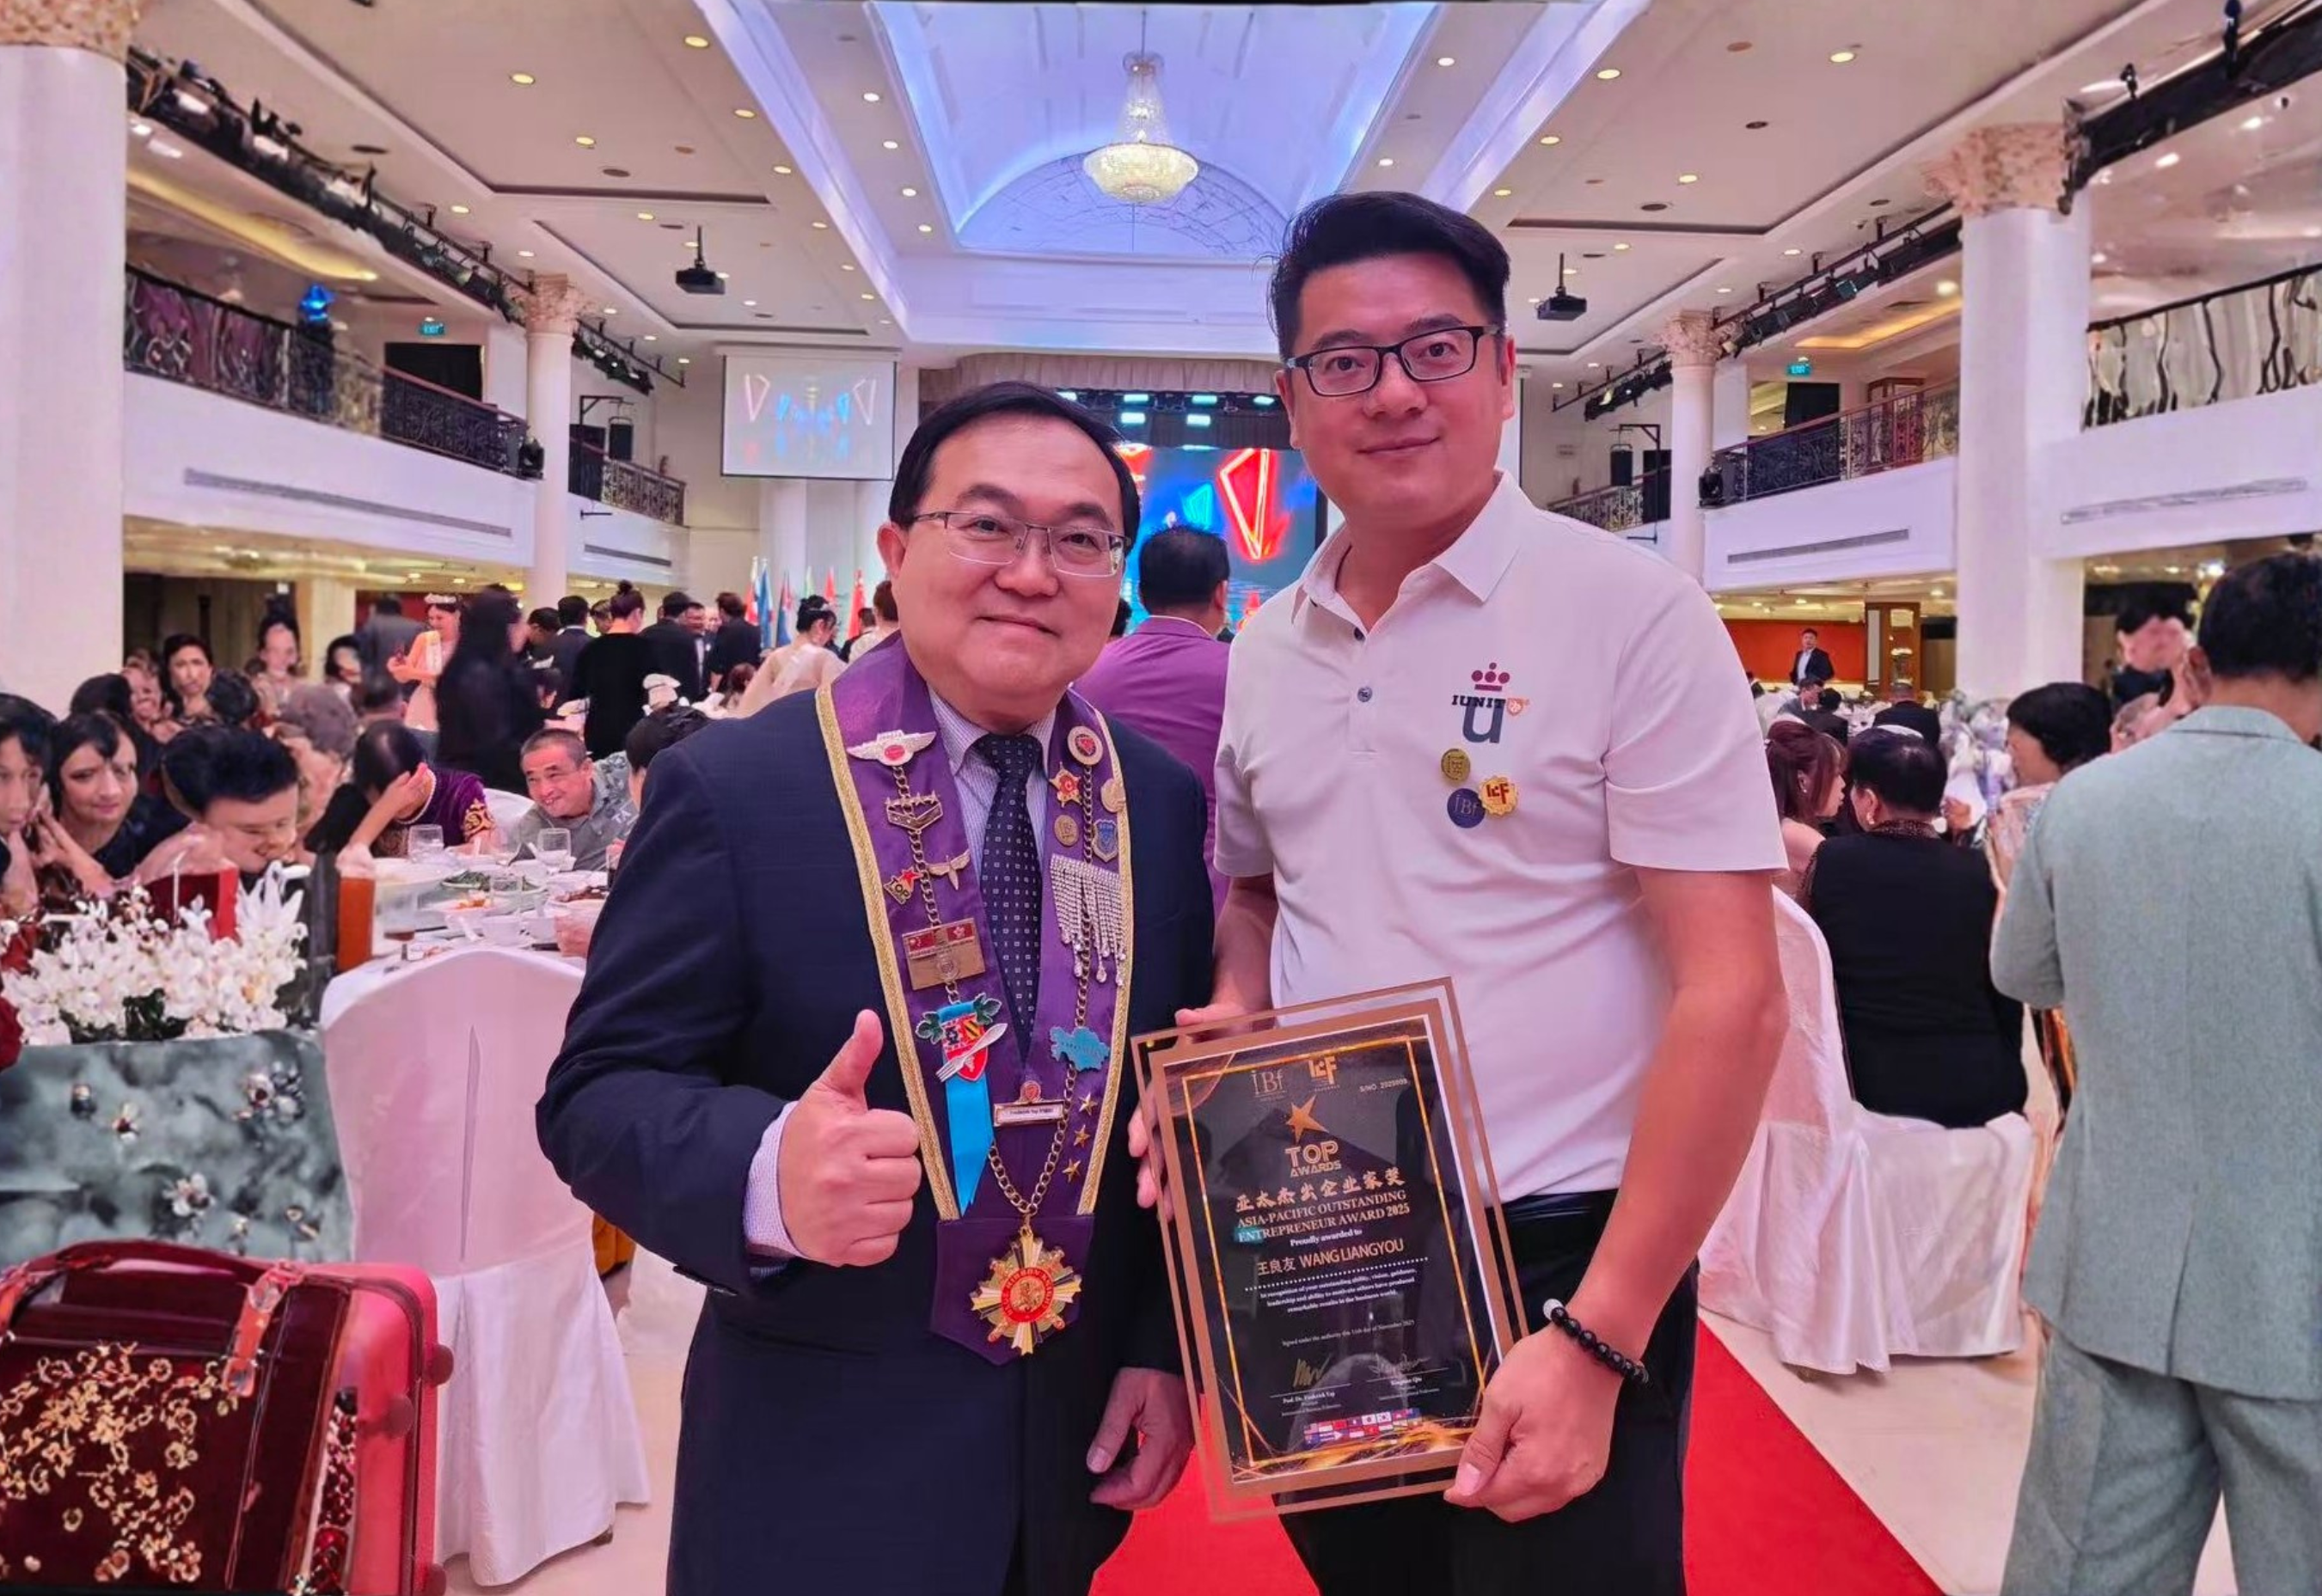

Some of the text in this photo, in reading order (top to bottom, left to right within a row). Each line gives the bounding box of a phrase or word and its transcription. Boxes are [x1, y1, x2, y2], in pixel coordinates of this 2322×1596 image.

[1284, 1140, 1339, 1168] TOP
[1290, 1160, 1342, 1177] AWARDS
[1238, 1189, 1406, 1228] ASIA-PACIFIC OUTSTANDING
[1238, 1202, 1410, 1243] ENTREPRENEUR AWARD 2025
[1290, 1235, 1319, 1247] Proudly
[1320, 1229, 1353, 1241] awarded
[1257, 1238, 1404, 1276] 王良友 WANG LIANGYOU
